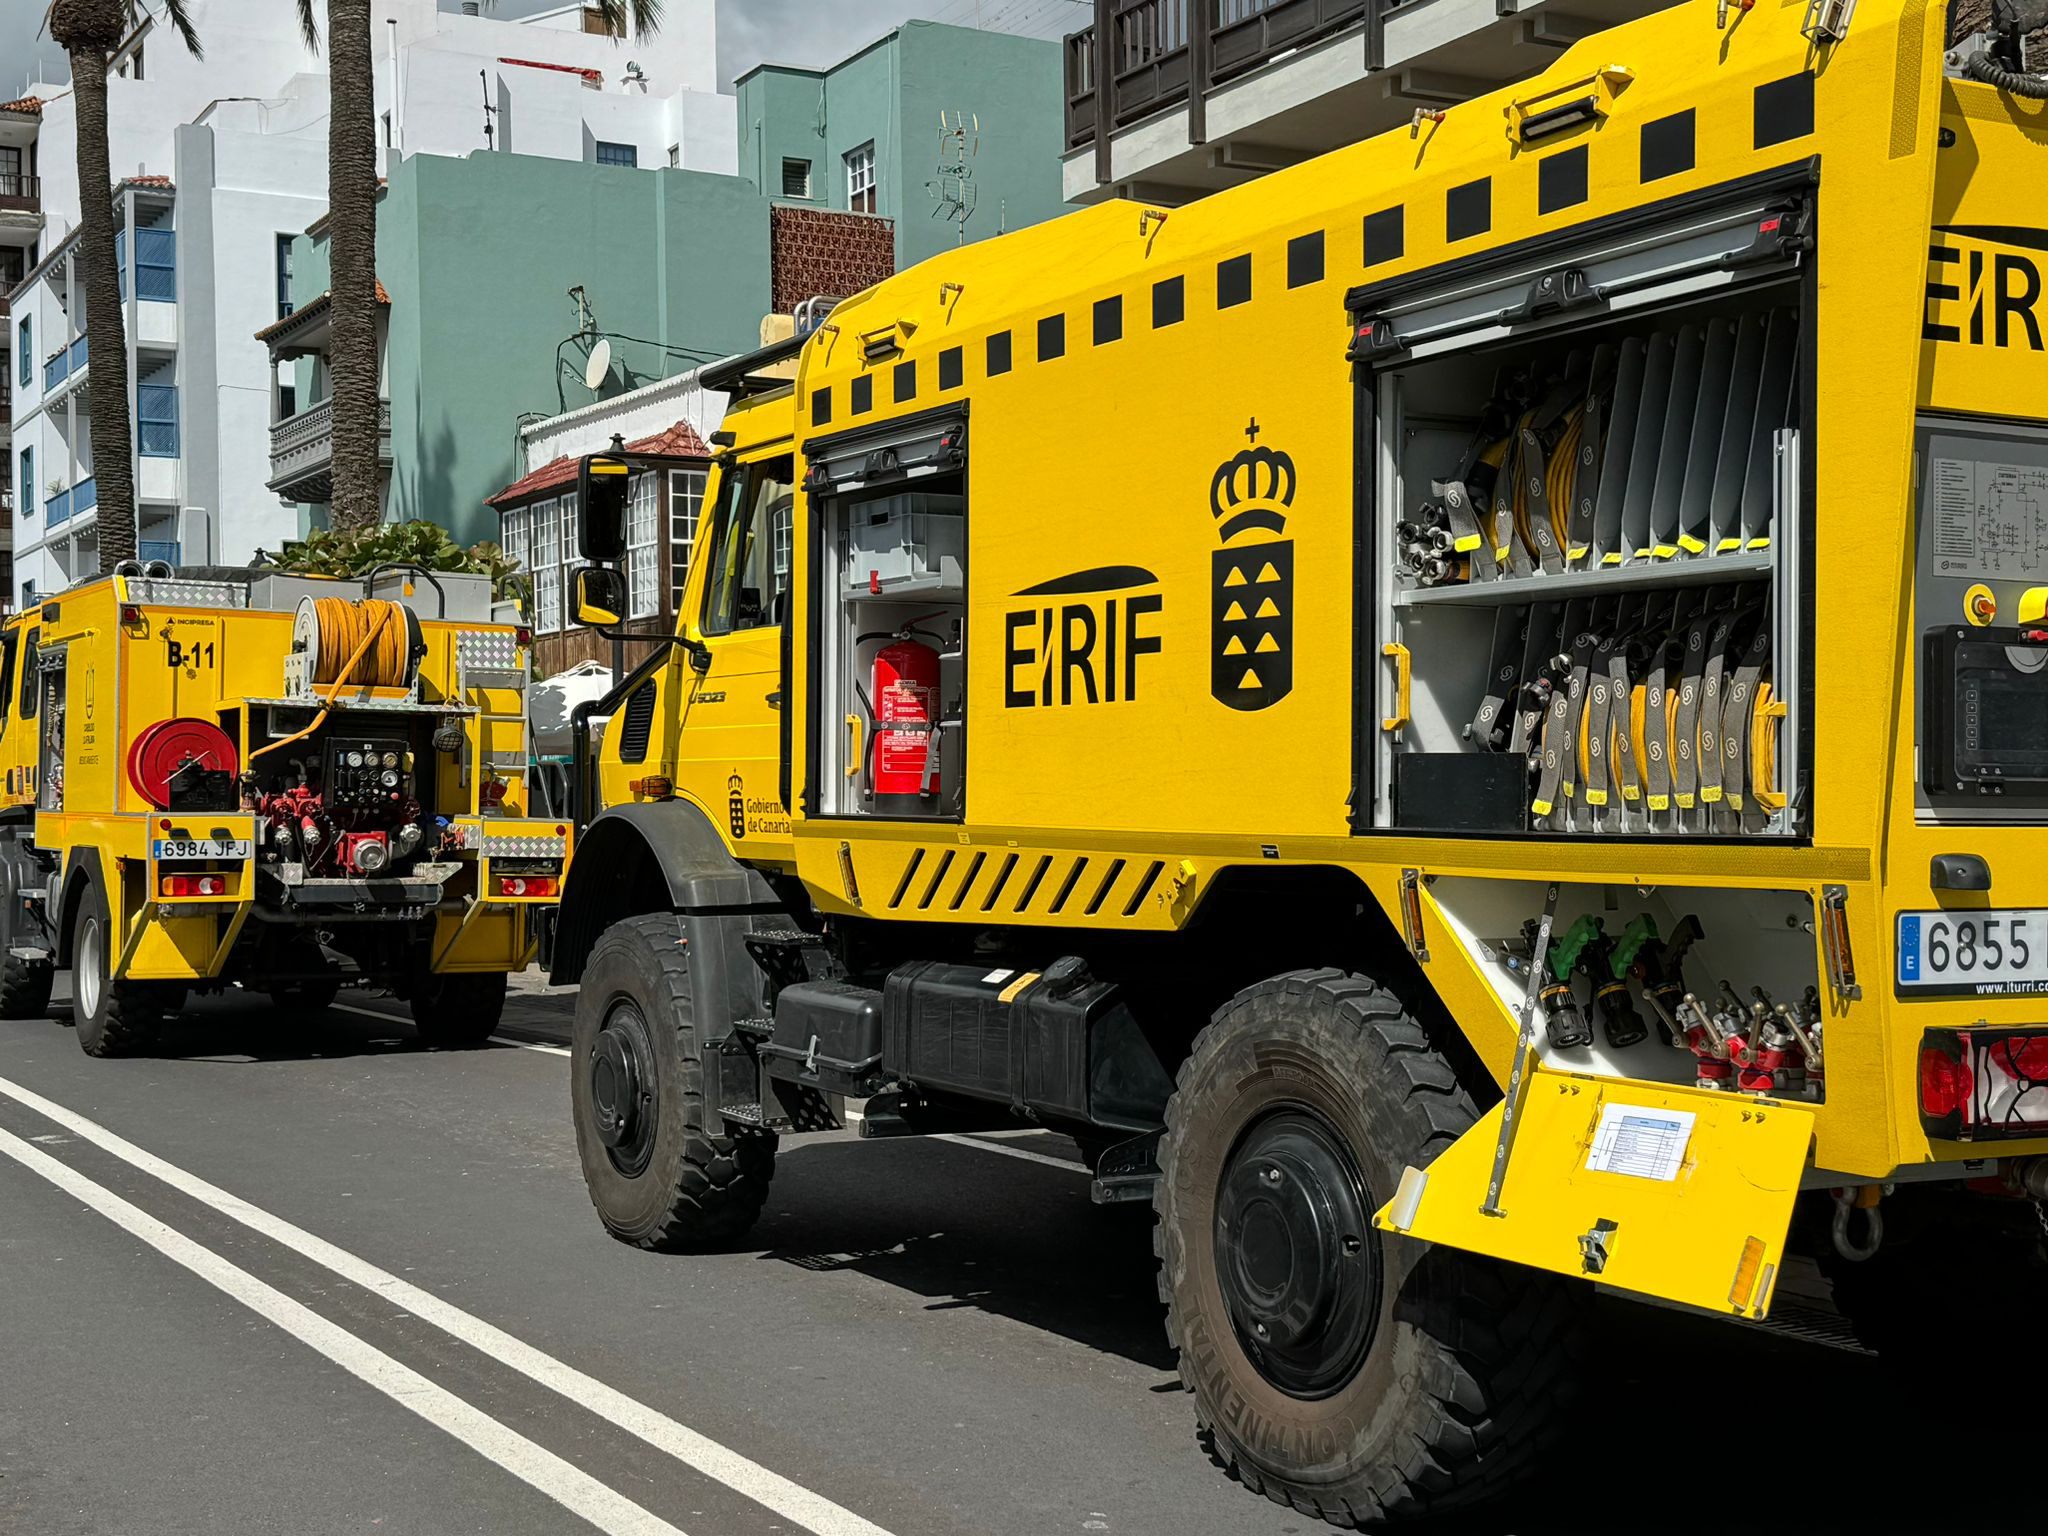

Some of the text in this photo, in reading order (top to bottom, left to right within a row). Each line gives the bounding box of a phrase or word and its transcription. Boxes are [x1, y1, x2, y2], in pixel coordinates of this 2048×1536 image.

[168, 640, 214, 669] B-11
[1005, 594, 1163, 709] EIRIF
[746, 797, 785, 814] Gobierno
[748, 817, 792, 834] de Canaria
[164, 841, 208, 857] 6984
[215, 840, 247, 857] JFJ
[1906, 919, 2030, 973] E 6855
